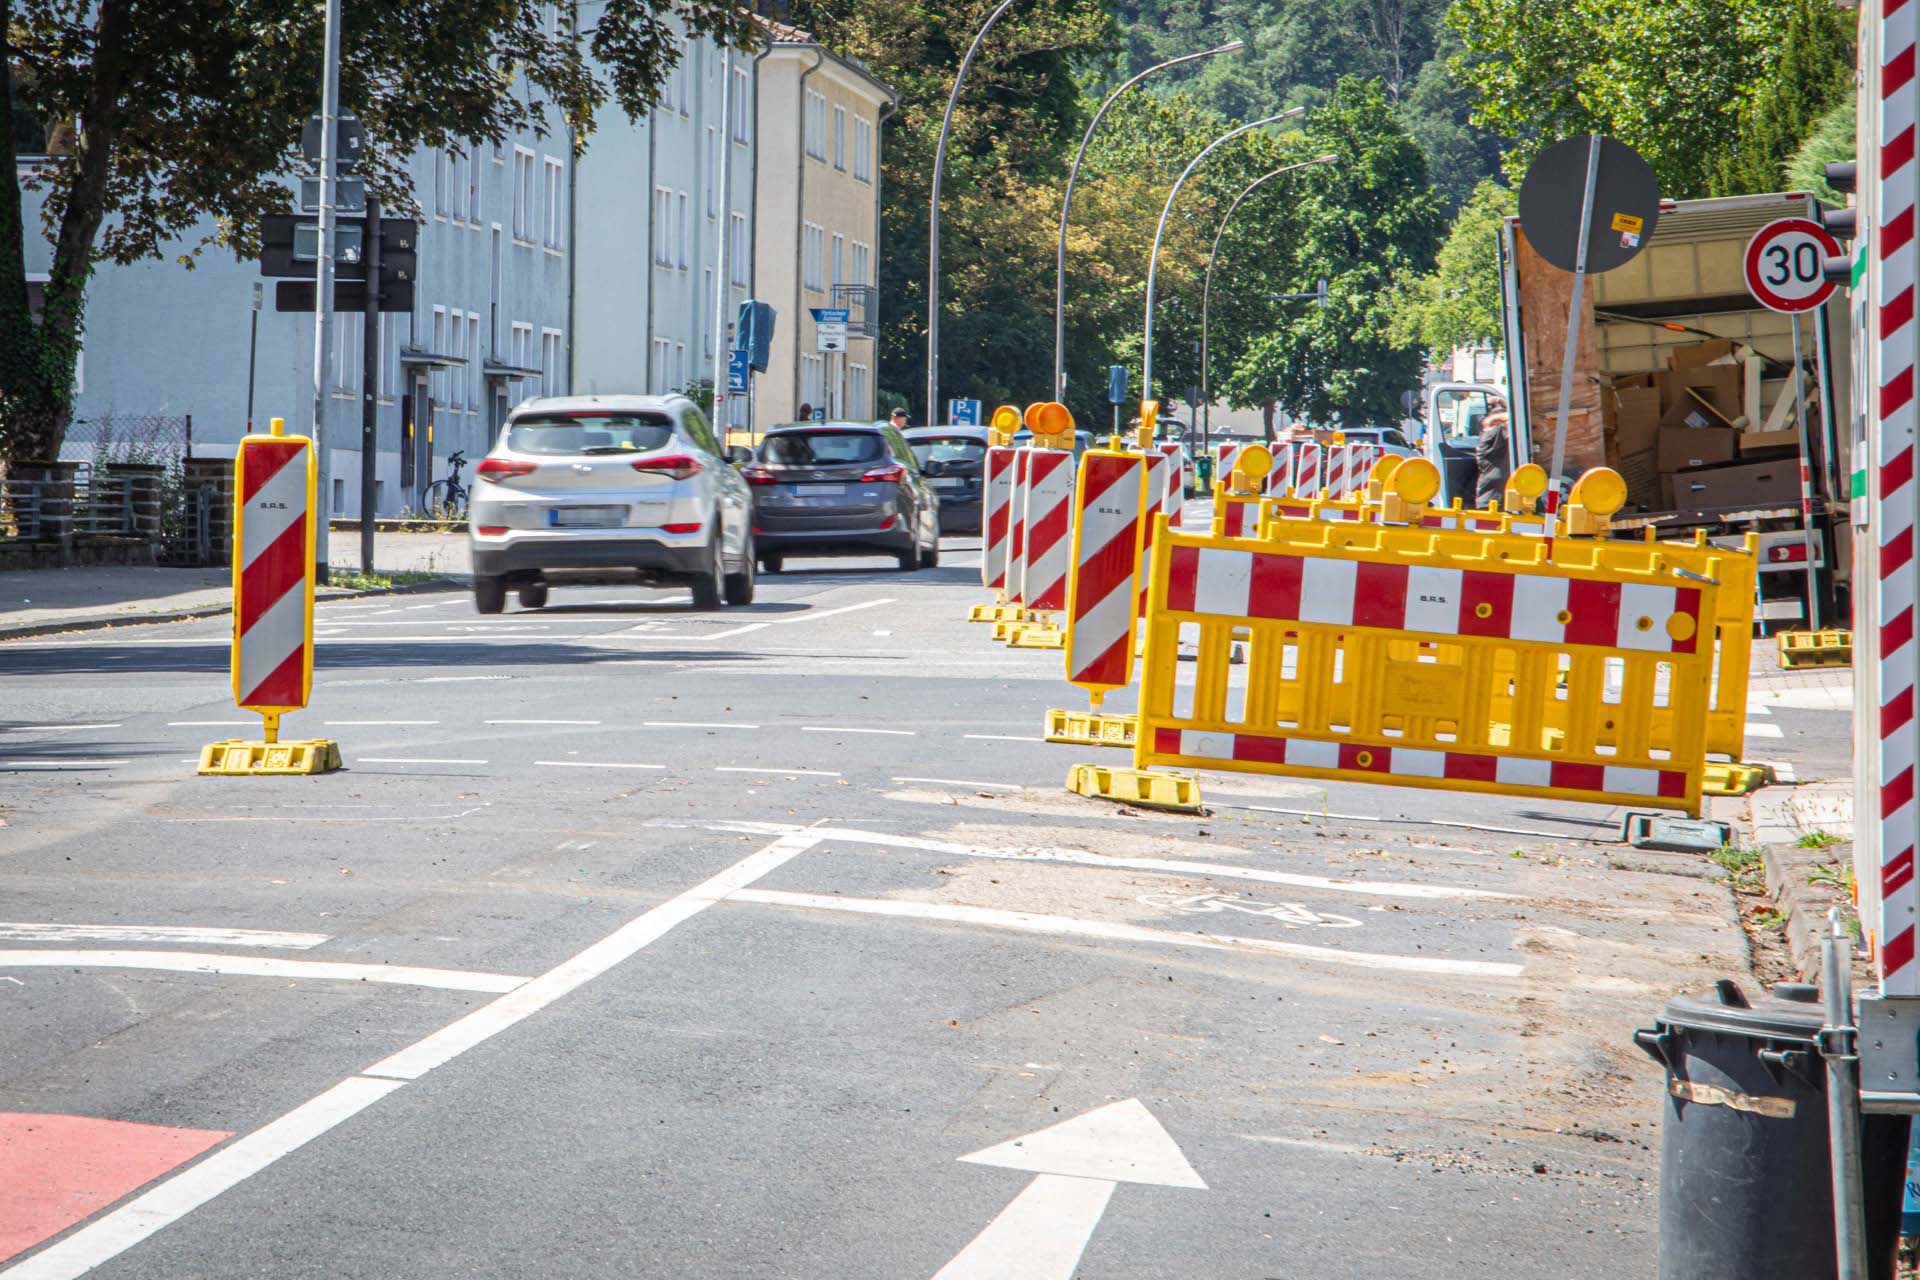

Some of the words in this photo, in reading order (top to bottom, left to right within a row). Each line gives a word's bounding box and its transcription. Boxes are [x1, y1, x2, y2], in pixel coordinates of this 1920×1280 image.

[1766, 242, 1819, 286] 30
[957, 400, 967, 414] P
[814, 410, 824, 420] P
